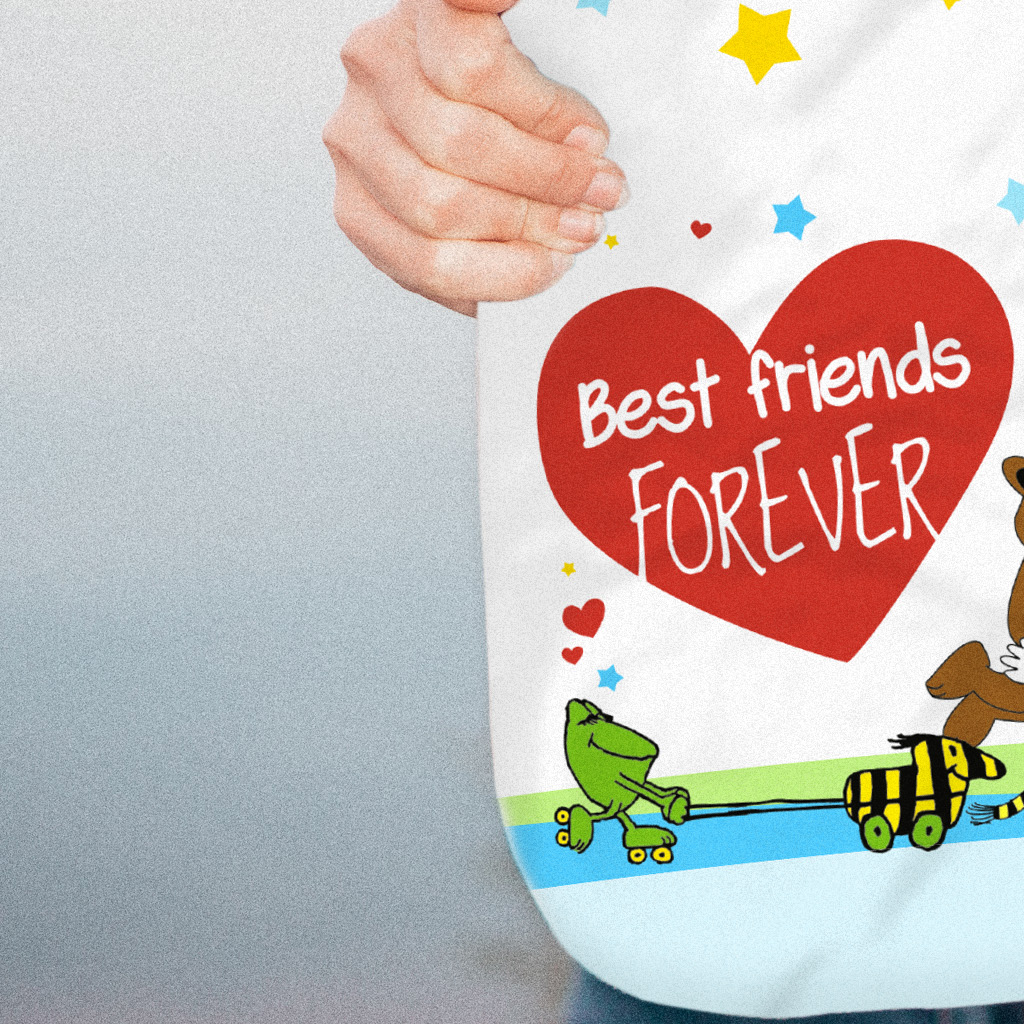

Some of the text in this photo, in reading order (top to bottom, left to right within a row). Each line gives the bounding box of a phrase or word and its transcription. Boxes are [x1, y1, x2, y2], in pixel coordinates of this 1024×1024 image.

[577, 320, 971, 449] Best friends
[628, 422, 940, 578] FOREVER
